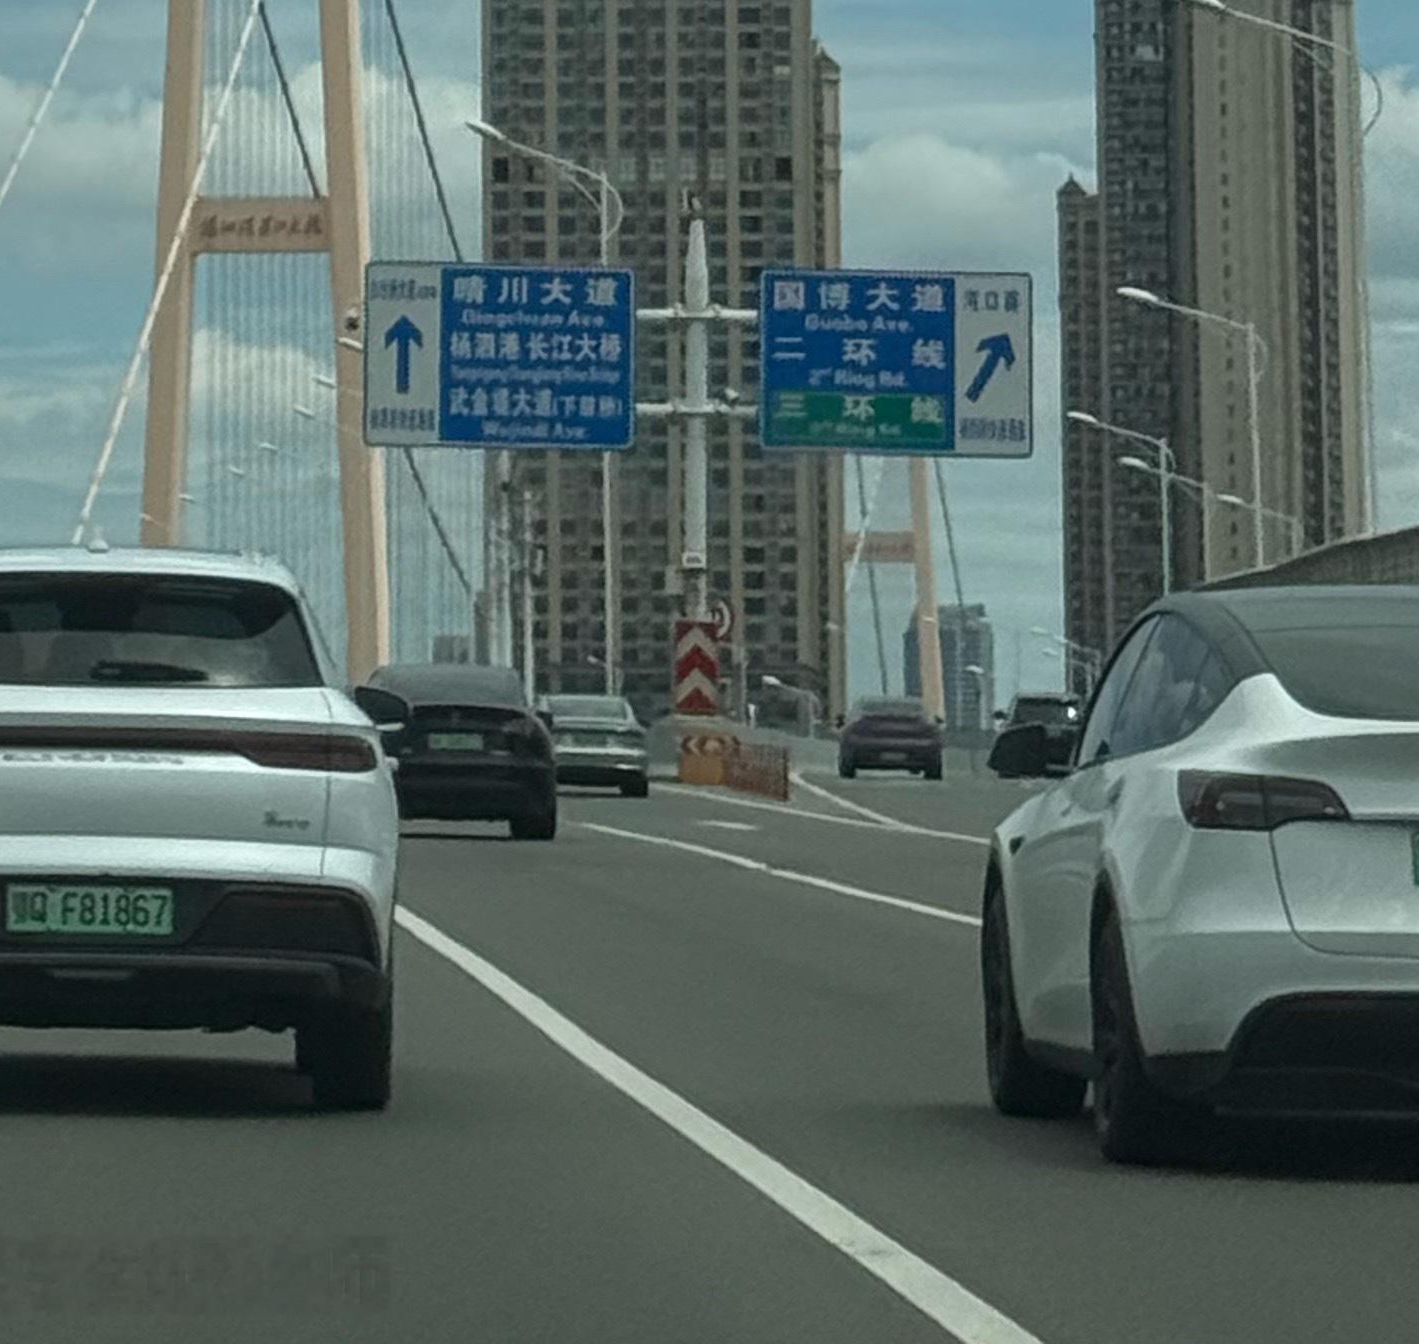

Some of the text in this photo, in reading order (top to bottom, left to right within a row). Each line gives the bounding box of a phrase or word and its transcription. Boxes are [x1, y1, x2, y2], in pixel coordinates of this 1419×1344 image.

[453, 275, 618, 305] 晴川大道
[774, 281, 946, 312] 国博大道
[805, 314, 867, 332] Guobo
[772, 337, 946, 369] 二环线
[774, 393, 944, 423] 三环线
[61, 892, 168, 926] F81867
